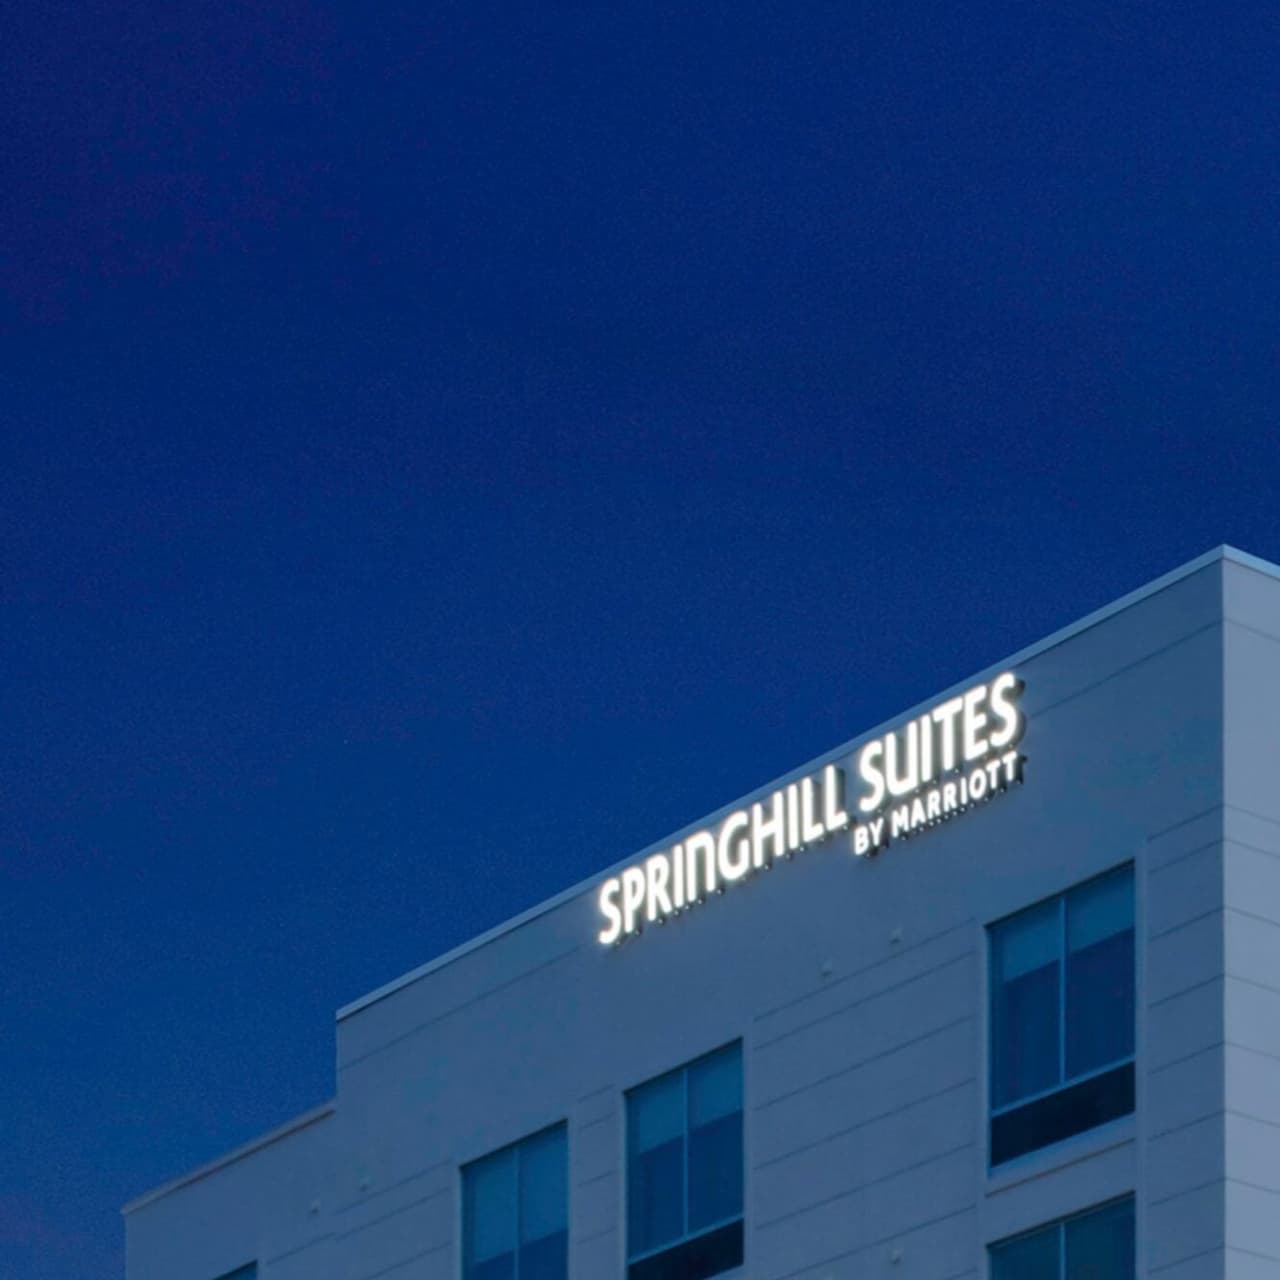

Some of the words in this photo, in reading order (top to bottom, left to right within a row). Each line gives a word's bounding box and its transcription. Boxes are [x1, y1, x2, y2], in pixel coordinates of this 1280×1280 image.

[598, 764, 847, 945] SPRINGHILL
[858, 672, 1018, 813] SUITES
[853, 823, 885, 856] BY
[891, 750, 1018, 838] MARRIOTT
